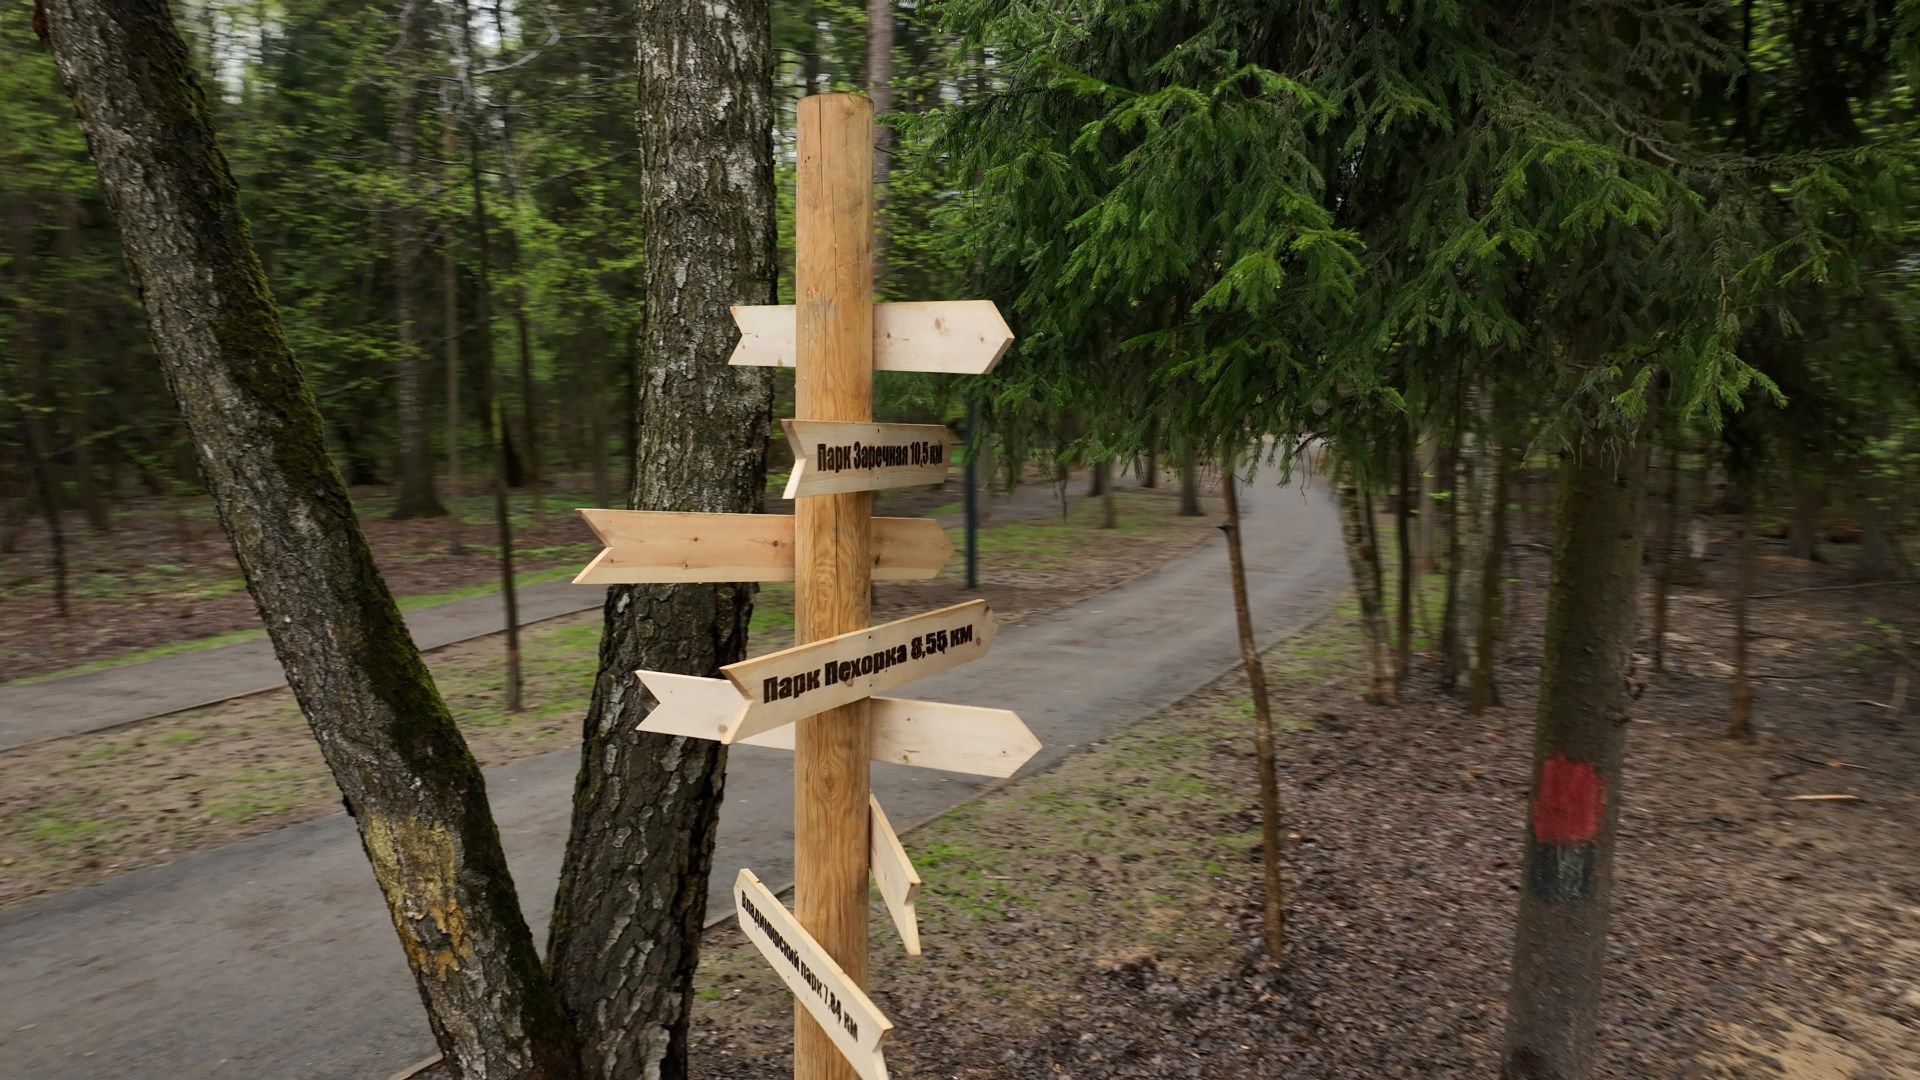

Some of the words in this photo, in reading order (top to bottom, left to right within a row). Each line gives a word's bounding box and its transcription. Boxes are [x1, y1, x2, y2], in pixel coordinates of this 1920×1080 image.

[817, 443, 851, 473] Парк
[853, 441, 908, 470] Заречная
[910, 441, 928, 468] 10,5
[929, 444, 943, 465] км
[763, 669, 821, 704] Парк
[824, 643, 907, 686] Пехорка
[911, 629, 949, 660] 8,55
[950, 624, 973, 648] км
[800, 960, 822, 1000] парк
[843, 1011, 858, 1042] км
